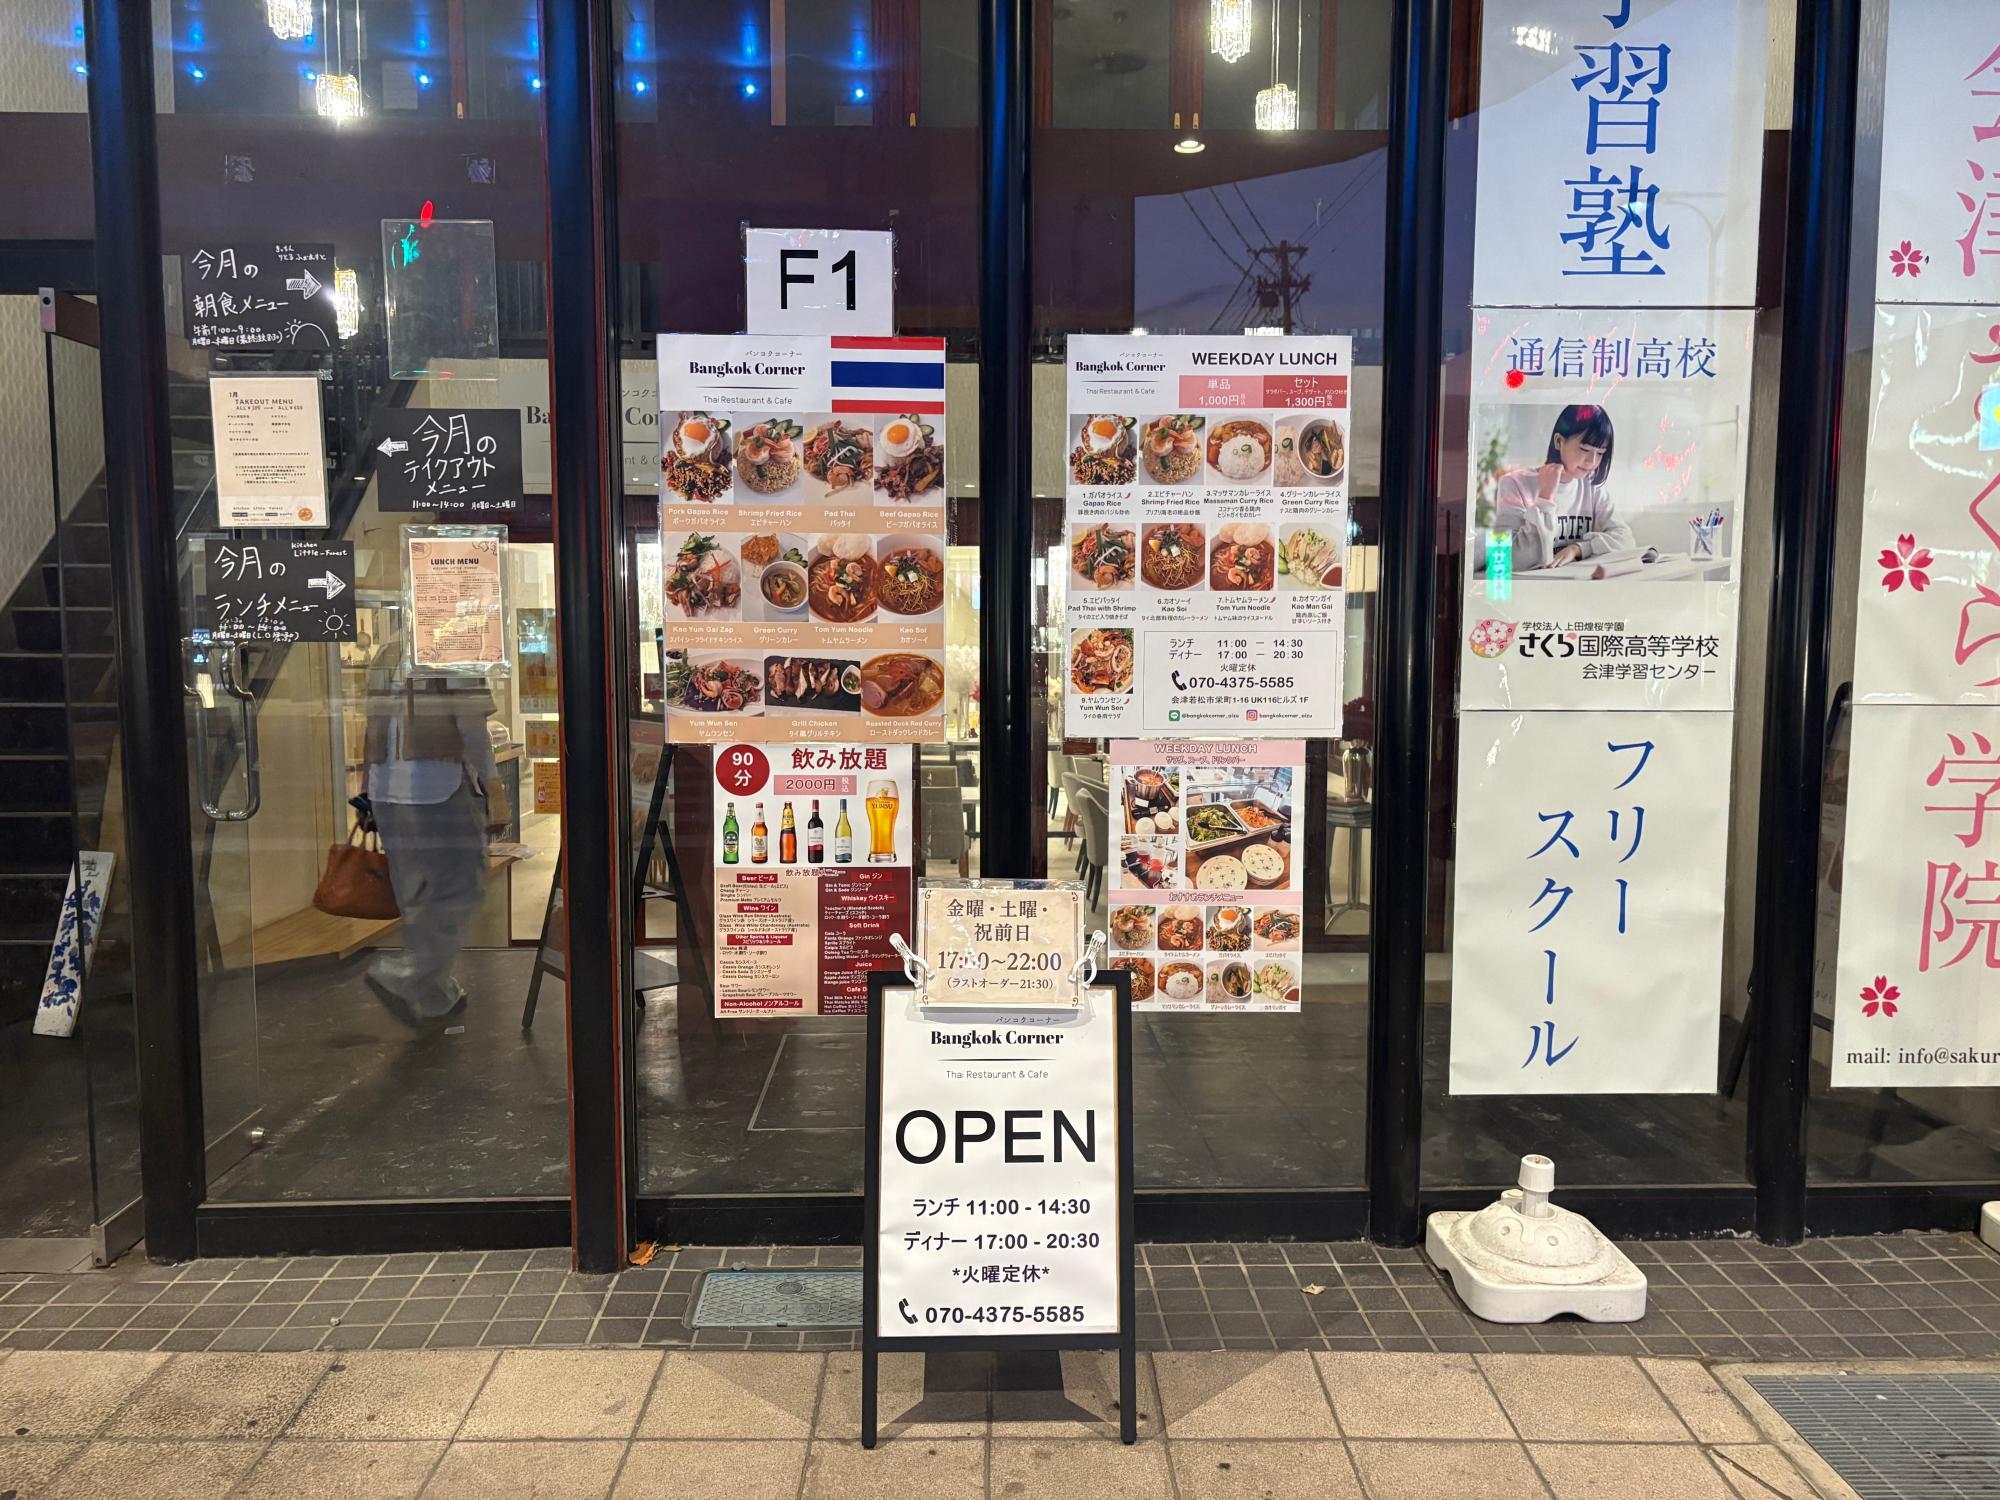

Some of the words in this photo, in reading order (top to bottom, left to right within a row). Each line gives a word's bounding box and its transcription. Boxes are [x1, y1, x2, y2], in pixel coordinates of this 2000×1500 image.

[1560, 0, 1671, 276] 習塾
[192, 248, 258, 280] 今月の
[780, 249, 856, 310] F1
[193, 291, 289, 317] 朝食メニュー
[1192, 352, 1275, 366] WEEKDAY
[1279, 352, 1337, 366] LUNCH
[1506, 336, 1718, 379] 通信制高校
[689, 361, 751, 377] Bangkok
[754, 362, 805, 376] Corner
[1075, 361, 1124, 374] Bangkok
[1126, 361, 1166, 372] Corner
[1208, 378, 1231, 389] 単品
[1294, 376, 1318, 388] セット
[703, 396, 720, 404] Thai
[720, 396, 764, 405] Restaurant
[774, 397, 793, 405] Cafe
[1199, 395, 1239, 407] 1,000円
[1285, 396, 1325, 407] 1,300円
[412, 414, 497, 457] 今月の
[403, 456, 496, 482] テイクアウト
[425, 481, 487, 496] メニュー
[214, 546, 286, 581] 今月の
[214, 593, 319, 620] ランチメニュー
[1113, 605, 1137, 613] Shrimp
[1522, 621, 1563, 632] 学校法人
[1169, 638, 1194, 649] ランチ
[1217, 639, 1247, 648] 11:00
[1273, 639, 1303, 648] 14:30
[1519, 632, 1719, 659] さくら国際高等学校
[1168, 650, 1202, 660] ディナー
[1217, 651, 1248, 660] 17:00
[1273, 651, 1304, 659] 20:30
[1220, 663, 1257, 672] 火曜定休
[1581, 662, 1717, 680] 会津学習センター
[1189, 676, 1294, 689] 070-4375-5585
[1171, 695, 1249, 704] 会津若松市栄町1-16
[1154, 743, 1213, 754] WEEKDAY
[1216, 743, 1258, 754] LUNCH
[732, 752, 754, 766] 90
[791, 747, 888, 770] 飲み放題
[734, 769, 753, 787] 分
[786, 779, 835, 791] 2000円
[1607, 740, 1655, 935] フリー
[946, 898, 1048, 919] 金曜・土曜・
[974, 922, 1030, 942] 祝前日
[1521, 810, 1580, 1069] スクール
[937, 951, 1062, 971] 17:0～22:00
[995, 1015, 1061, 1024] バンコクコーナー
[931, 1030, 1002, 1049] Bangkok
[1005, 1030, 1064, 1045] Corner
[1846, 1047, 1891, 1064] mail:
[946, 1070, 964, 1079] Thai
[966, 1070, 1016, 1079] Restaurant
[1018, 1071, 1025, 1079] &
[1027, 1070, 1049, 1079] Cafe
[895, 1109, 1096, 1164] OPEN
[913, 1198, 960, 1217] ランチ
[966, 1199, 1019, 1215] 11:00
[1037, 1199, 1091, 1215] 14:30
[903, 1231, 968, 1251] ディナー
[974, 1233, 1028, 1250] 17:00
[1046, 1233, 1100, 1249] 20:30
[925, 1305, 1085, 1324] 070-4375-5585
